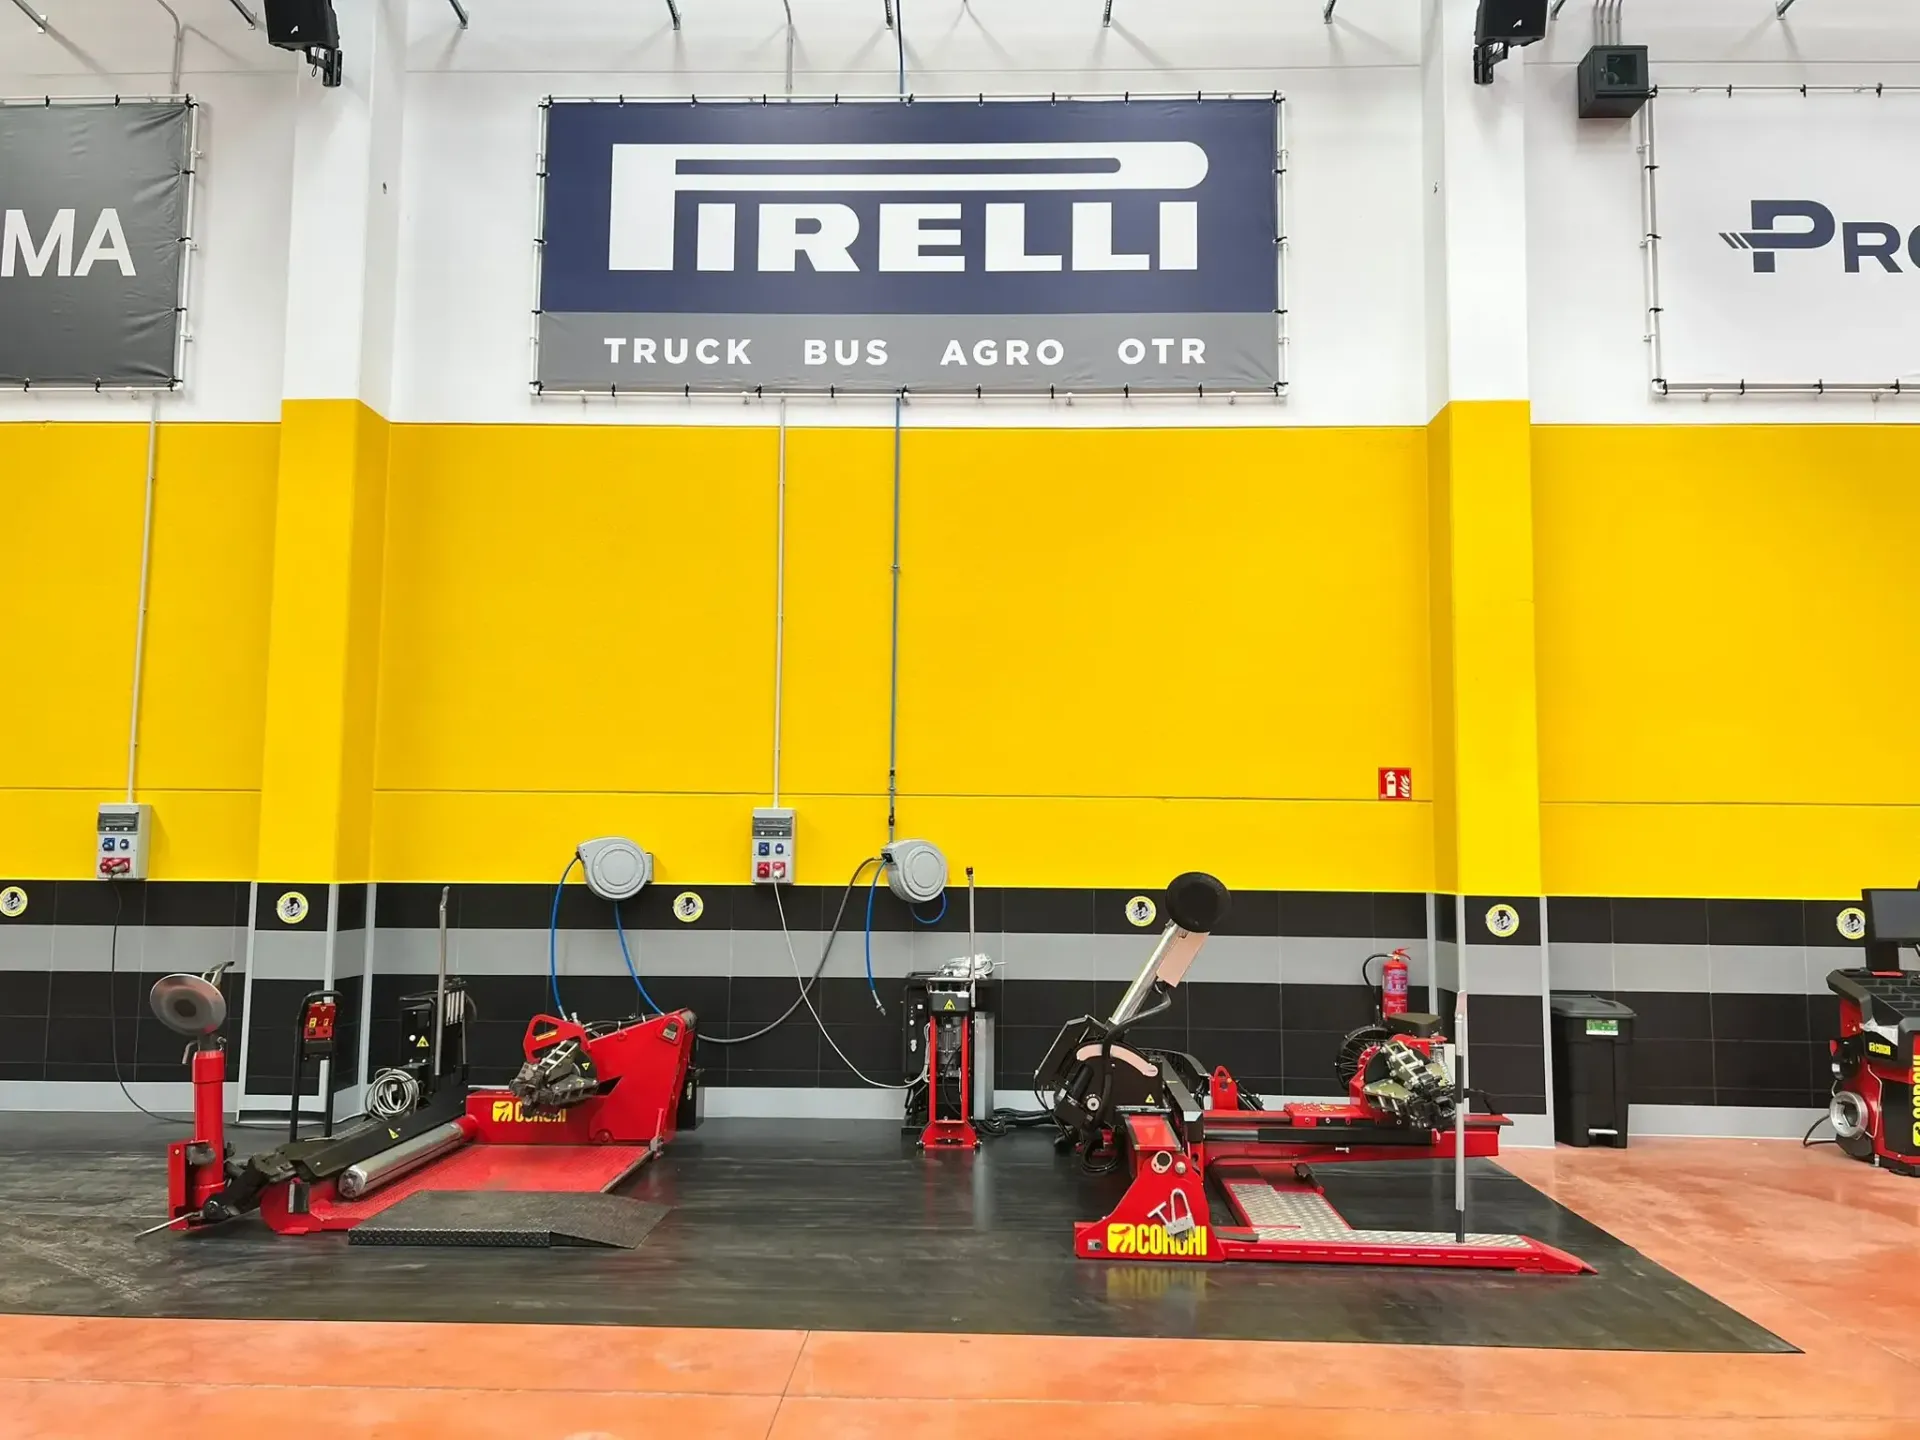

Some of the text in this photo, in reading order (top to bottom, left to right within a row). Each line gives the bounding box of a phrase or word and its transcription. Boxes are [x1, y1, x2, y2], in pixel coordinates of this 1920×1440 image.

[0, 207, 136, 277] MA
[608, 141, 1209, 272] PIRELLI
[1718, 198, 1920, 274] PR
[604, 337, 1207, 367] TRUCK BUS AGRO OTR
